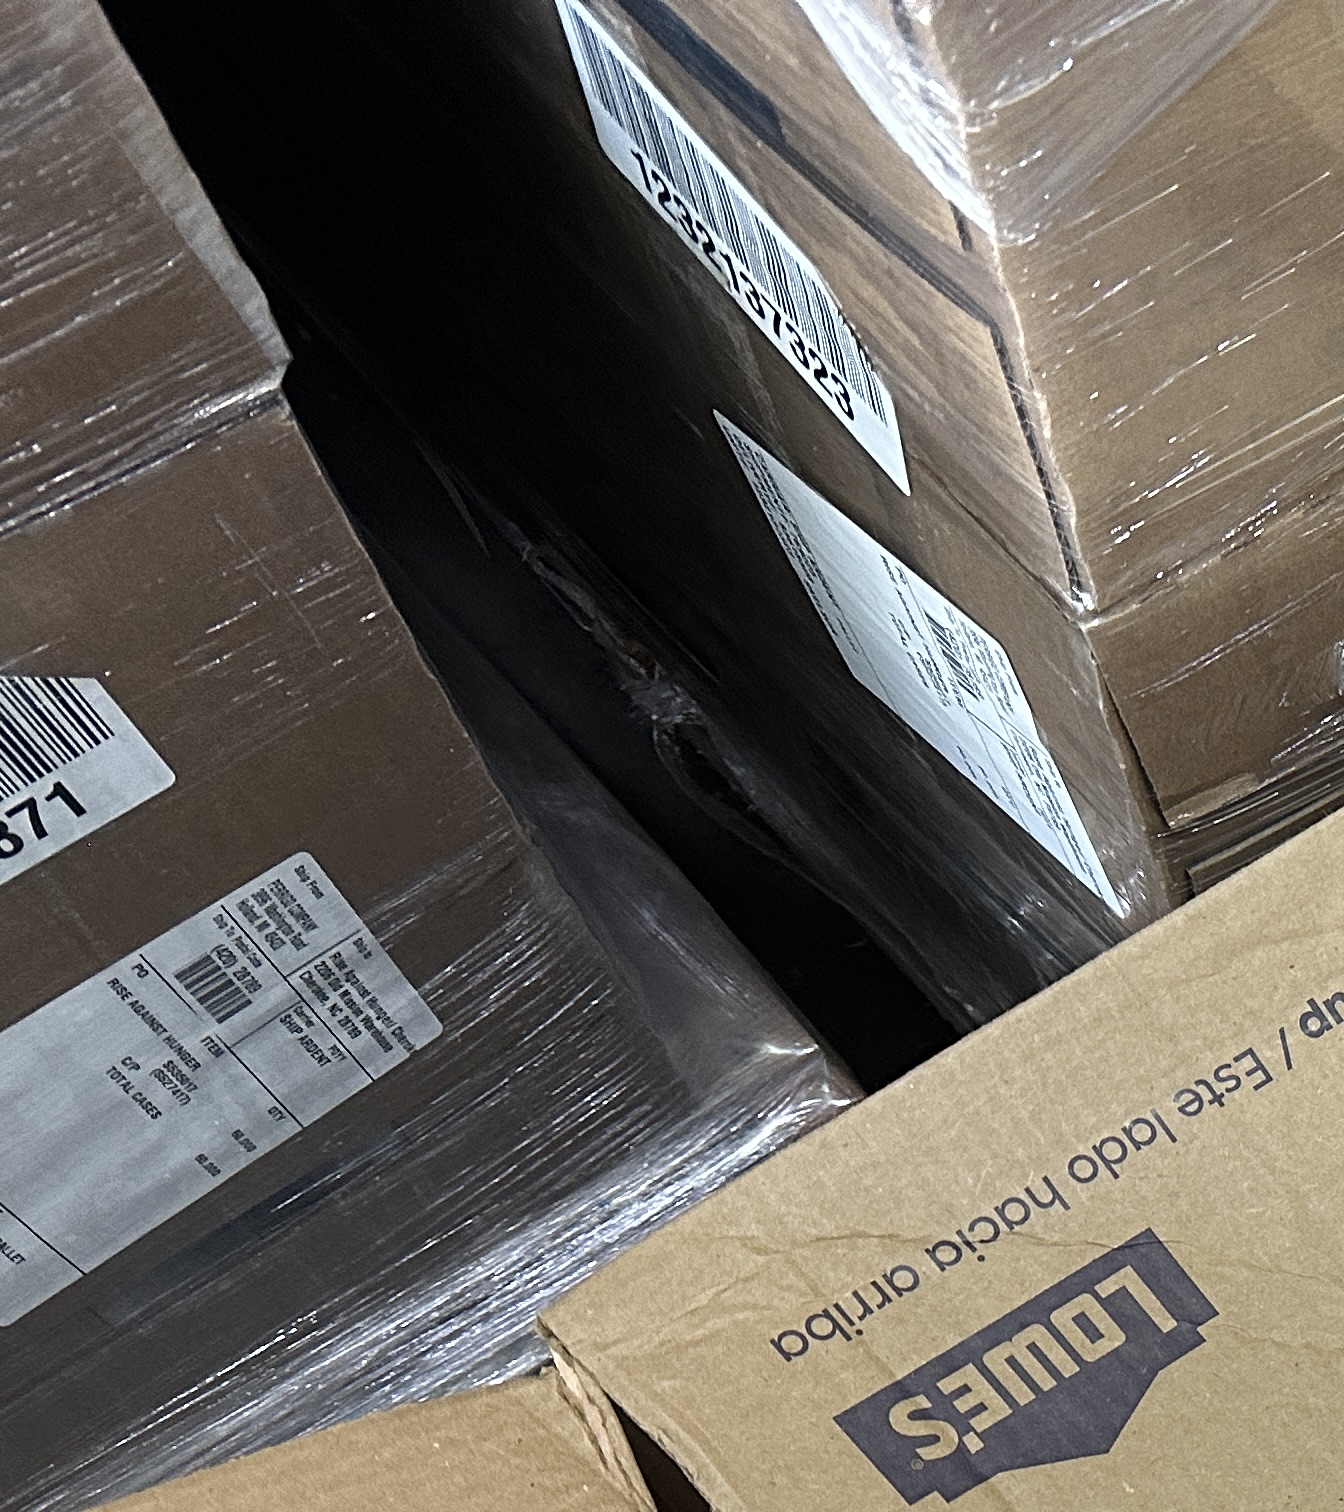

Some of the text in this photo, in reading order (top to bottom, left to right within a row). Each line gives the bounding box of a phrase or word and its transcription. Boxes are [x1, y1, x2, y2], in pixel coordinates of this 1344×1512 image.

[632, 151, 854, 421] 1232137323
[130, 961, 149, 980] PO
[106, 975, 201, 1075] RISE AGAINST HUNGER
[199, 1034, 224, 1060] ITEM
[278, 1011, 303, 1039] SHIP
[104, 1063, 162, 1123] TOTAL CASES
[1175, 1047, 1273, 1116] Este
[1068, 1112, 1177, 1183] lado
[924, 1176, 1070, 1272] hacia
[770, 1265, 919, 1362] arriba
